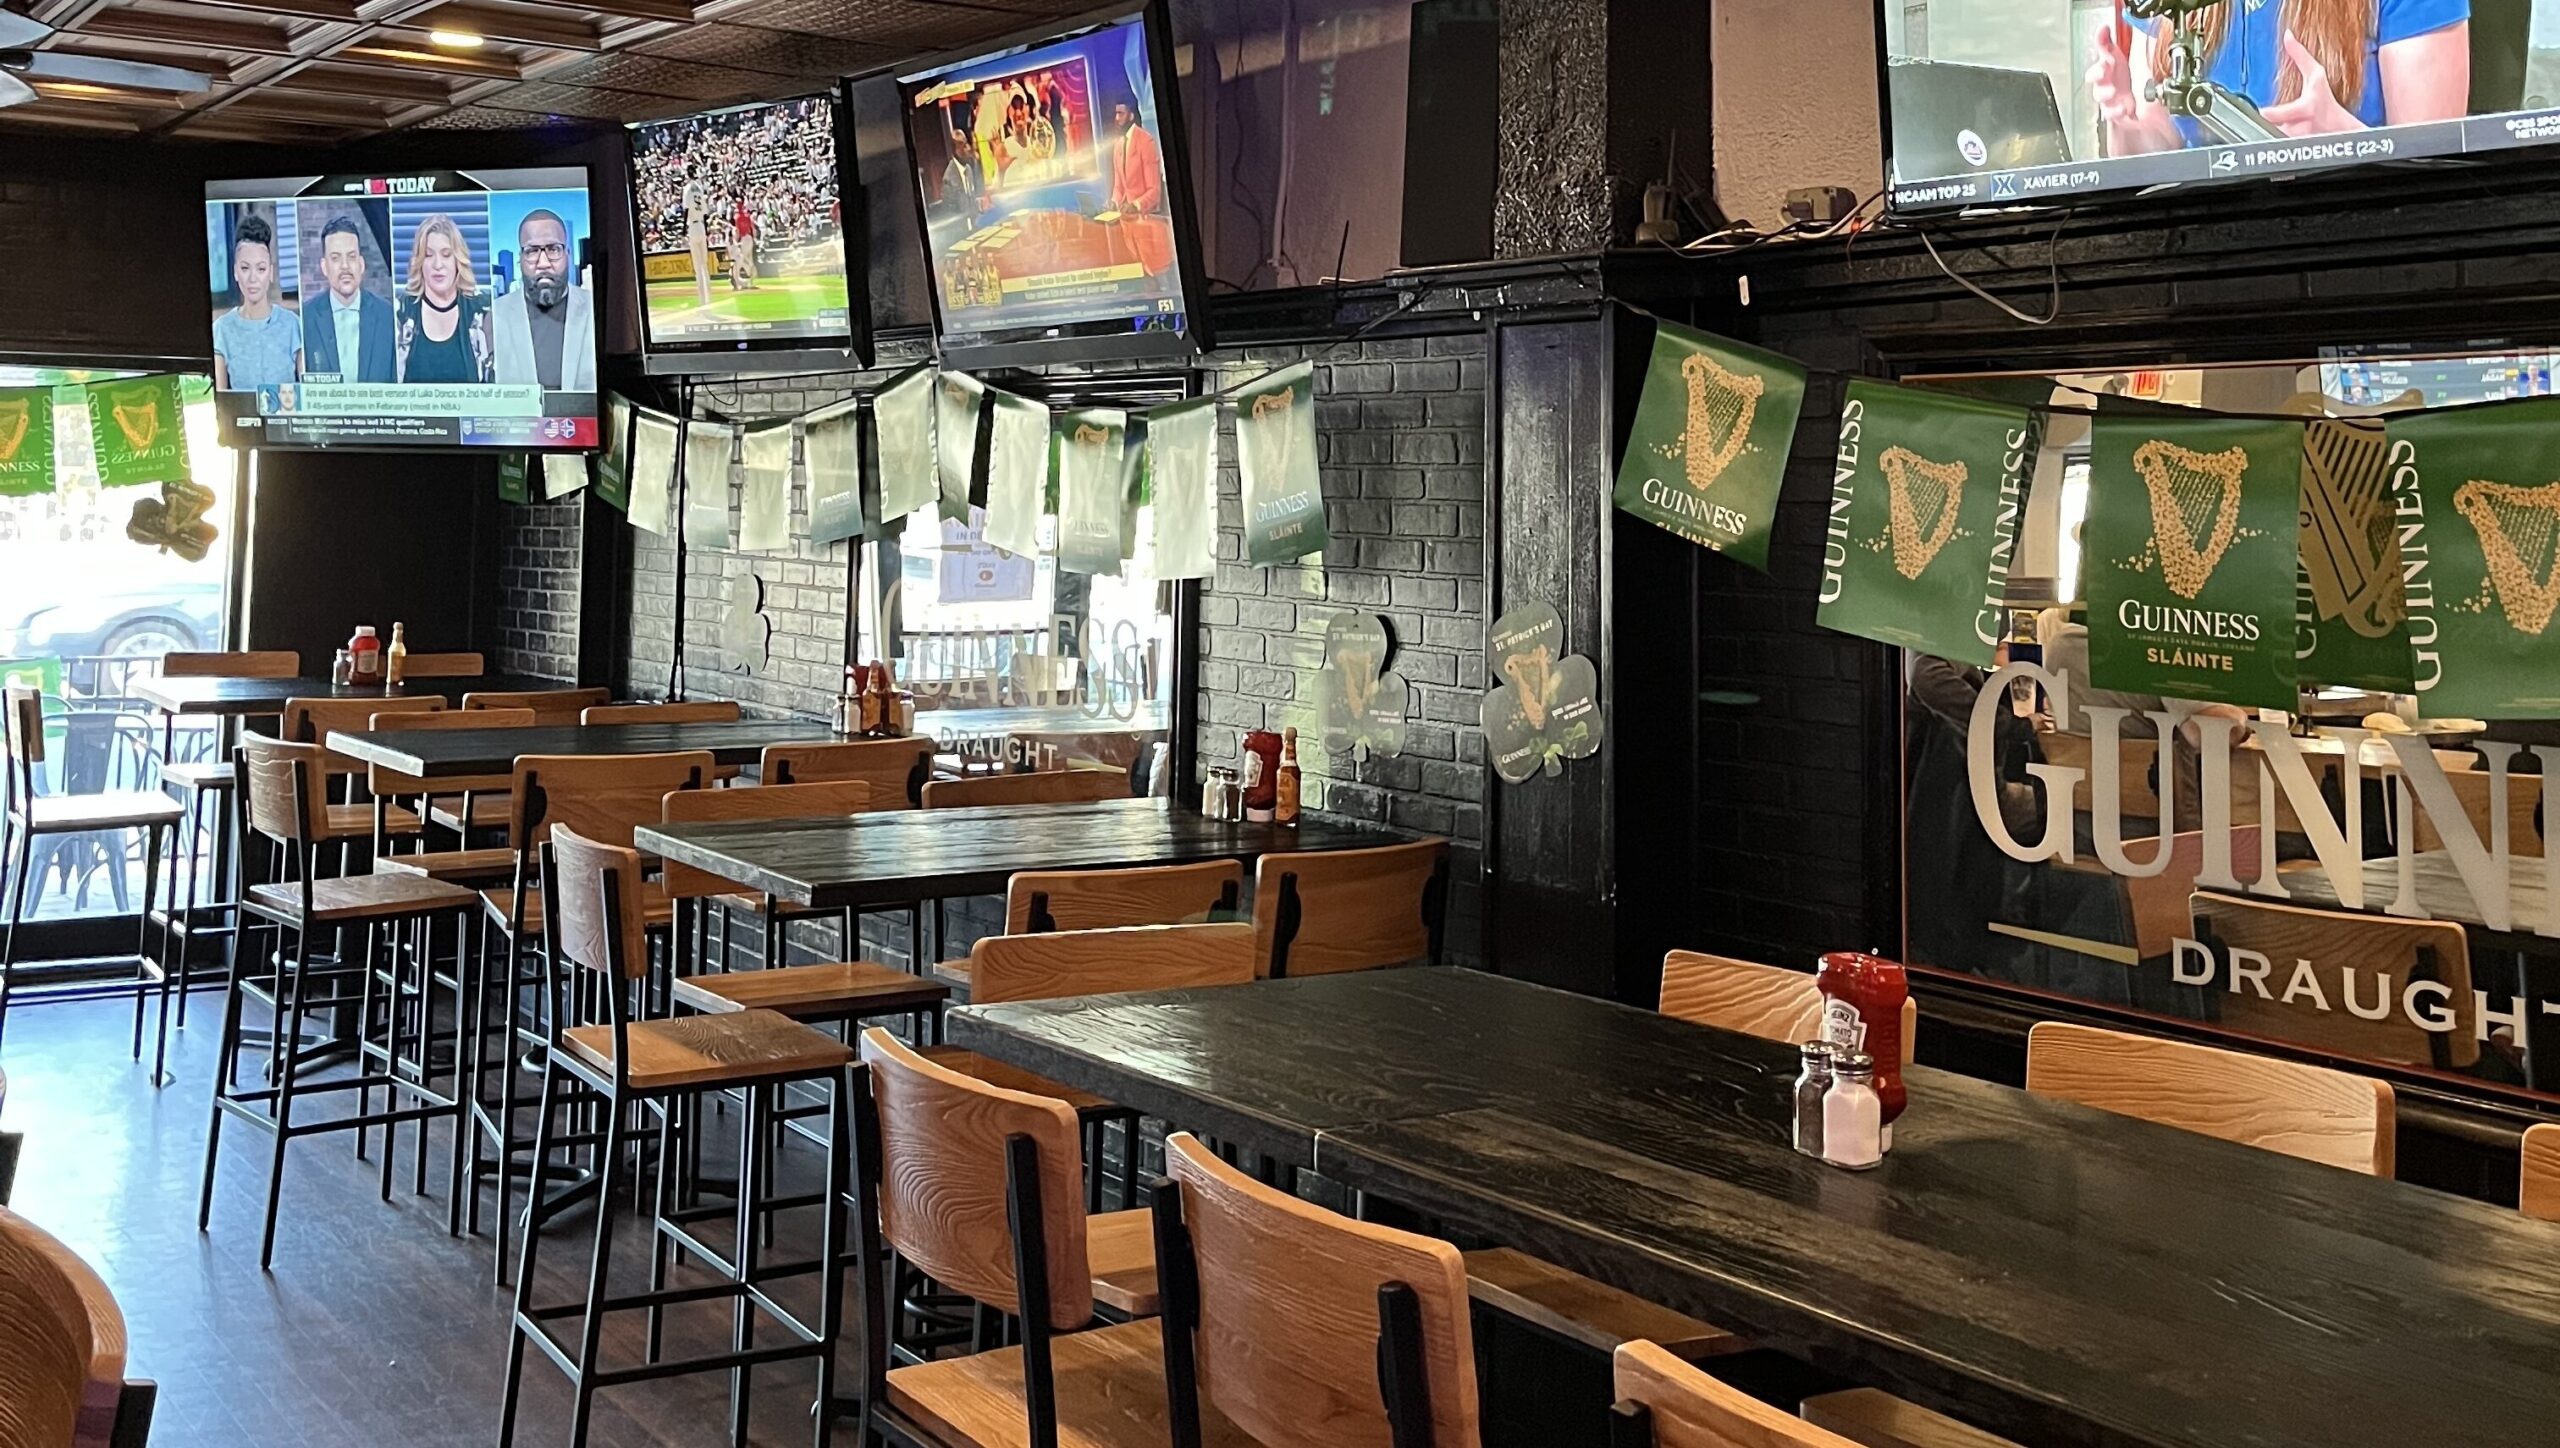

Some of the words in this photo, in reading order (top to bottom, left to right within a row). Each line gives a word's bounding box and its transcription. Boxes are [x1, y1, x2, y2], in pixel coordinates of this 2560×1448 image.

[2537, 114, 2560, 127] SPO
[2245, 154, 2257, 167] 11
[2258, 142, 2354, 164] PROVIDENCE
[2356, 138, 2394, 158] (22-3)
[386, 176, 436, 193] TODAY
[1896, 187, 1937, 204] NCAAM
[1939, 186, 1960, 200] TOP
[1962, 184, 1976, 198] 25
[2023, 174, 2068, 190] XAVIER
[2071, 171, 2099, 187] (17-9)
[1256, 490, 1309, 523] GUINNESS
[1642, 478, 1747, 535] GUINNESS
[2118, 599, 2260, 641] GUINNESS
[2147, 646, 2234, 671] SLÁINTE
[940, 727, 1058, 770] DRAUGHT
[2172, 936, 2560, 1049] DRAUGH
